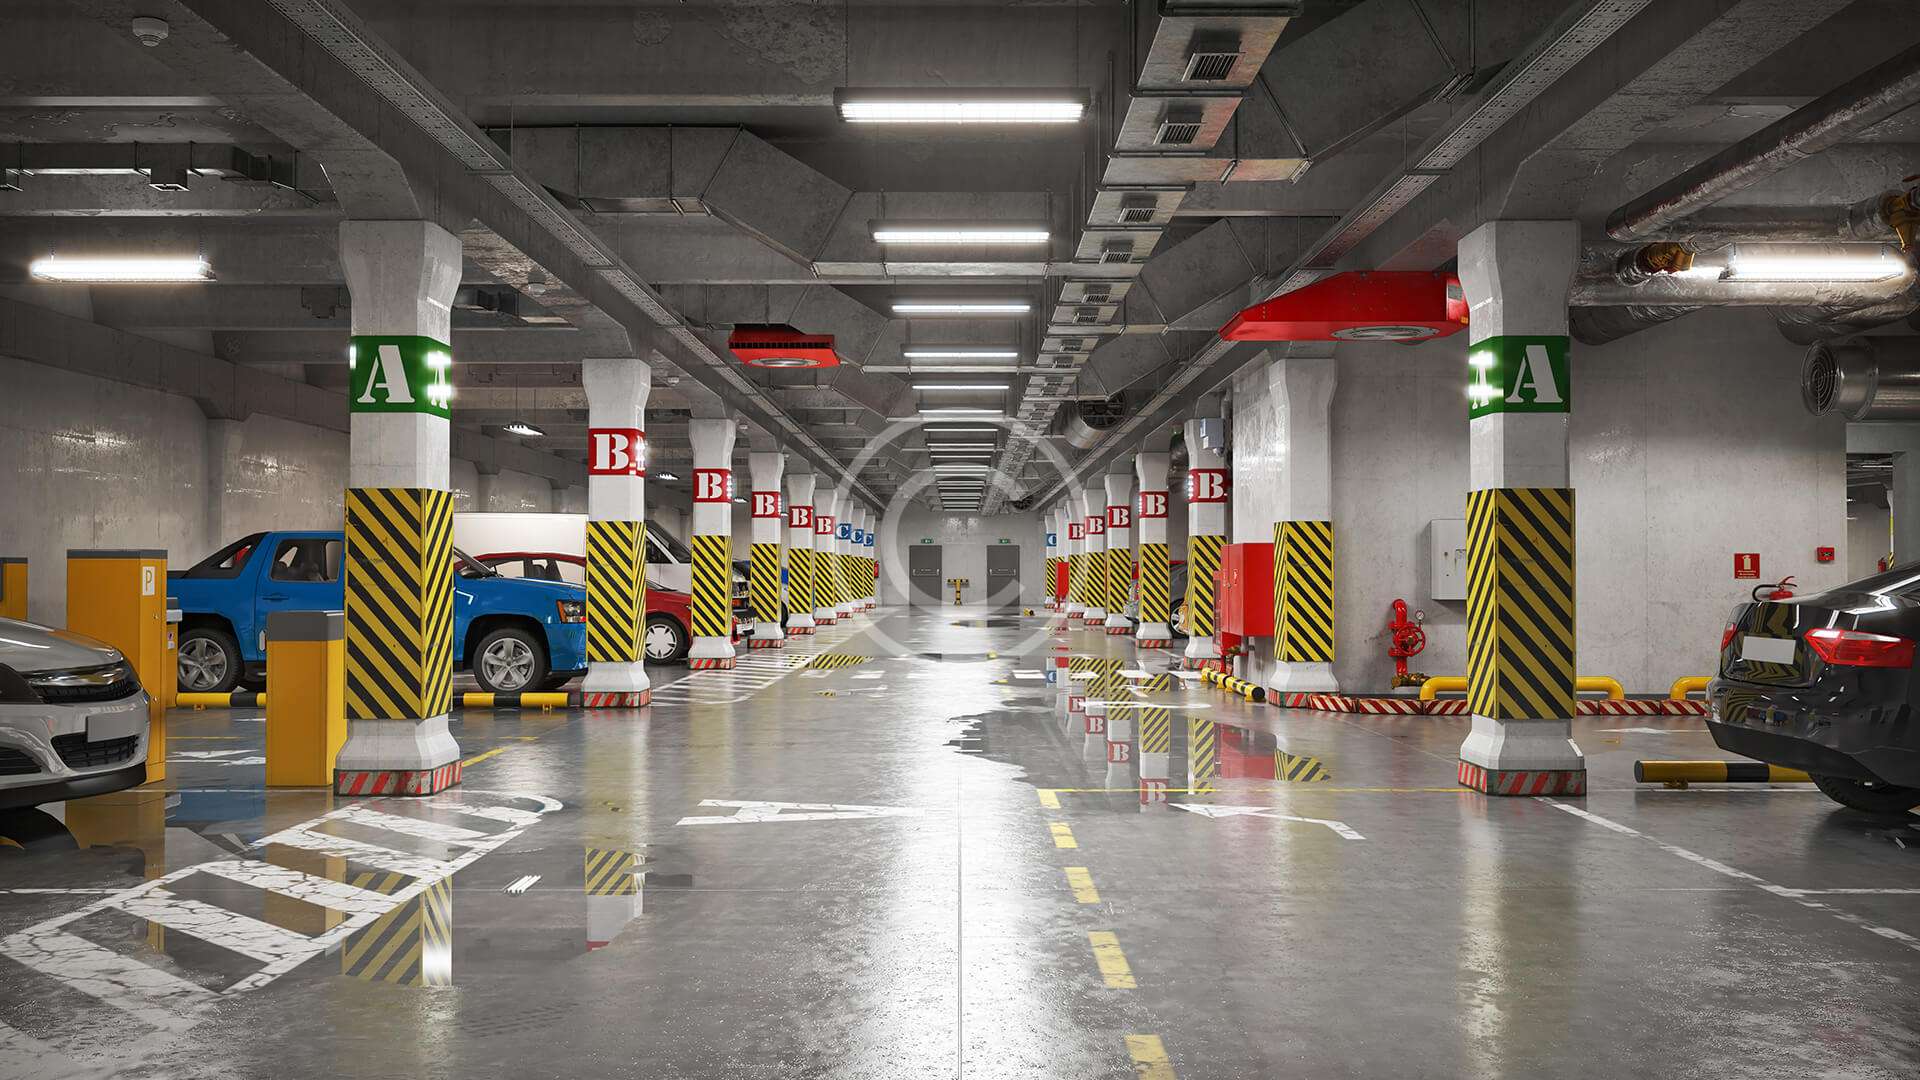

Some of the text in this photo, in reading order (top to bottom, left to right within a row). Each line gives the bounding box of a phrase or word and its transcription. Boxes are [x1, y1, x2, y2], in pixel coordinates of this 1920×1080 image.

[357, 344, 415, 403] A
[1504, 344, 1563, 403] A
[593, 433, 629, 470] B
[696, 472, 723, 499] B
[1198, 472, 1224, 499] B
[754, 494, 775, 515] B
[1145, 494, 1167, 515] B
[791, 508, 808, 526] B
[816, 517, 832, 533] B
[1088, 517, 1104, 533] B
[1112, 508, 1129, 526] B
[836, 524, 849, 538] C
[850, 530, 862, 542] C
[863, 534, 873, 545] C
[1072, 524, 1085, 539] B
[145, 570, 153, 592] P
